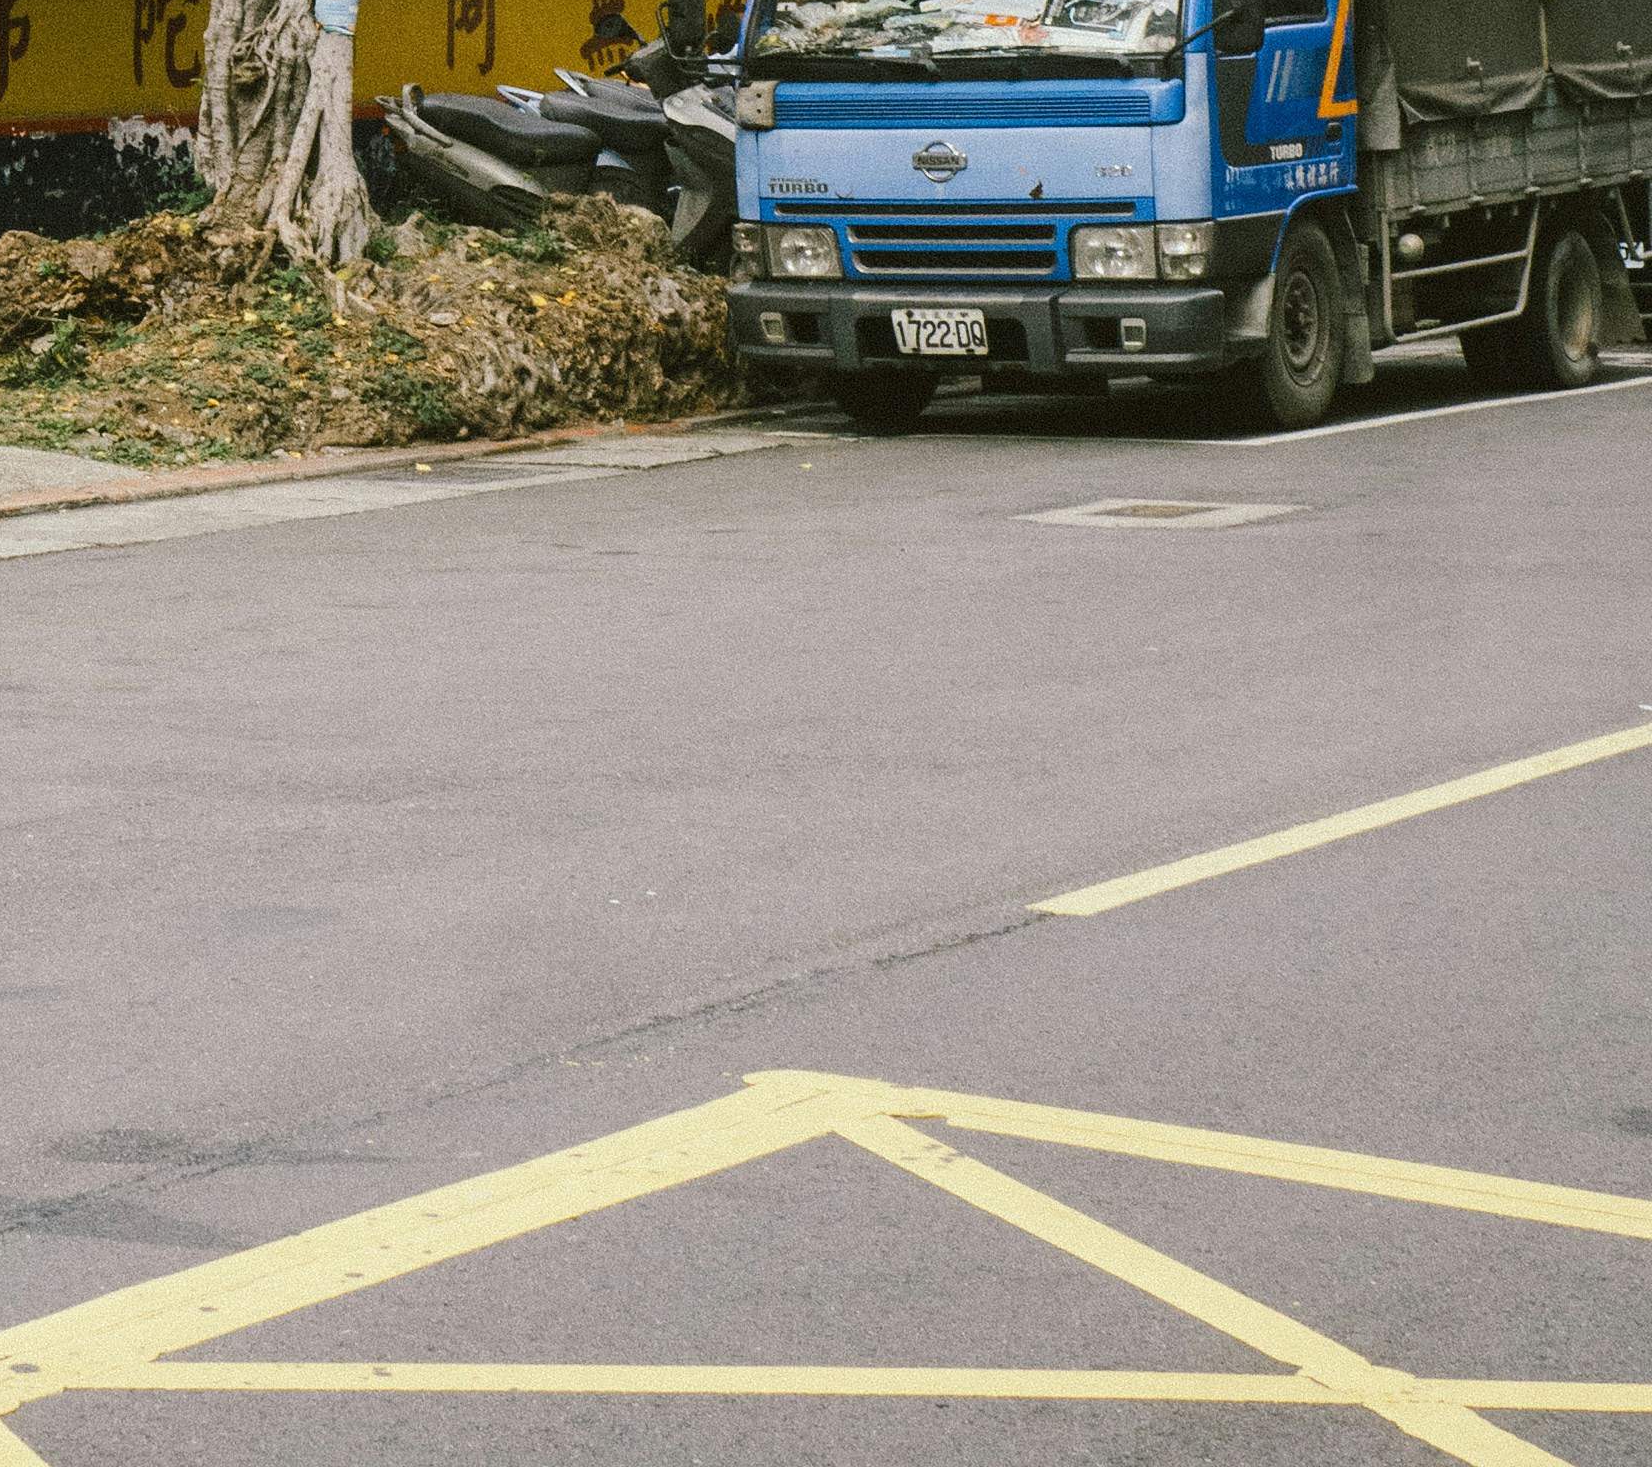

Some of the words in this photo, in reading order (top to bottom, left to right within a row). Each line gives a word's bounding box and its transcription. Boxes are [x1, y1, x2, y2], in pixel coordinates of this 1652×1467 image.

[1268, 142, 1304, 161] TURBO
[916, 154, 960, 166] NISSAN
[768, 183, 829, 195] TURBO
